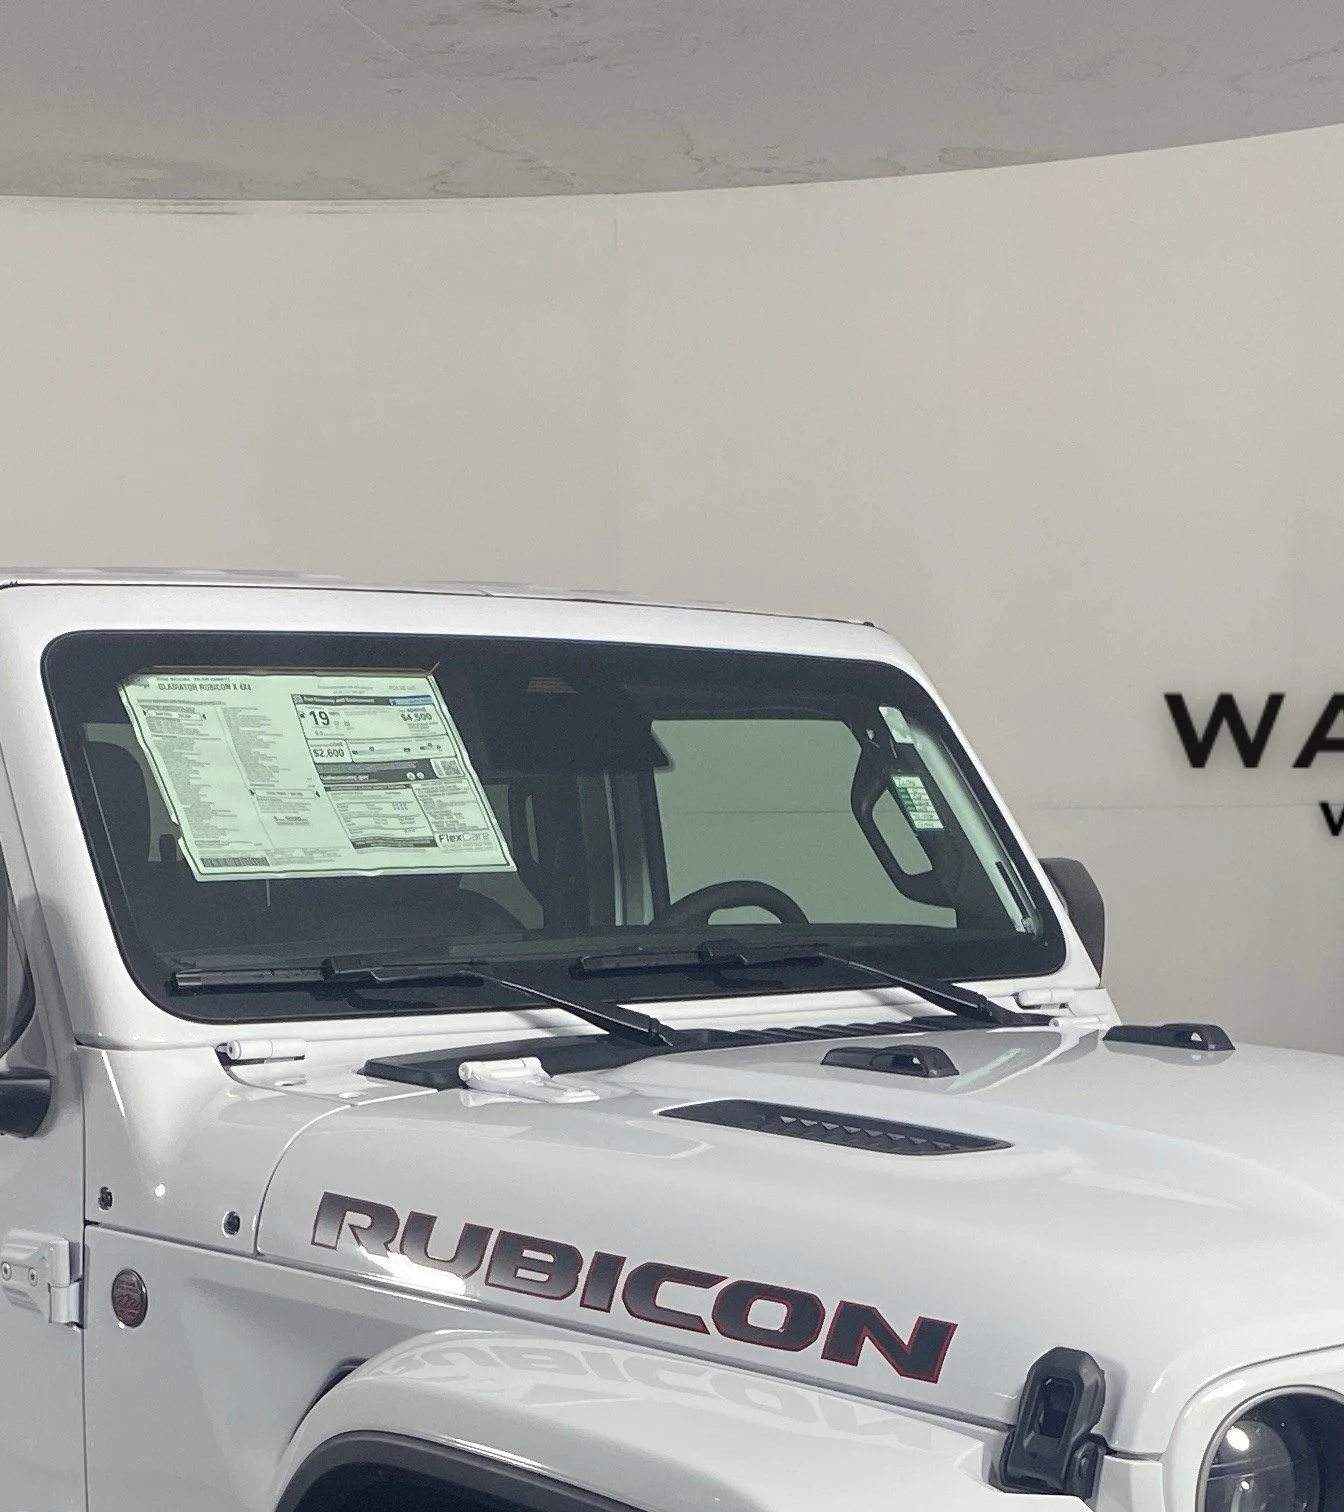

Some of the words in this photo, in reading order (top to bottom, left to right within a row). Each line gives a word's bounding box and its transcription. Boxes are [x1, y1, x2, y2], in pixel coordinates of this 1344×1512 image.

[309, 710, 331, 726] 19
[312, 748, 345, 758] $2,600
[438, 832, 489, 843] FlexCare
[309, 1190, 959, 1385] RUBICON
